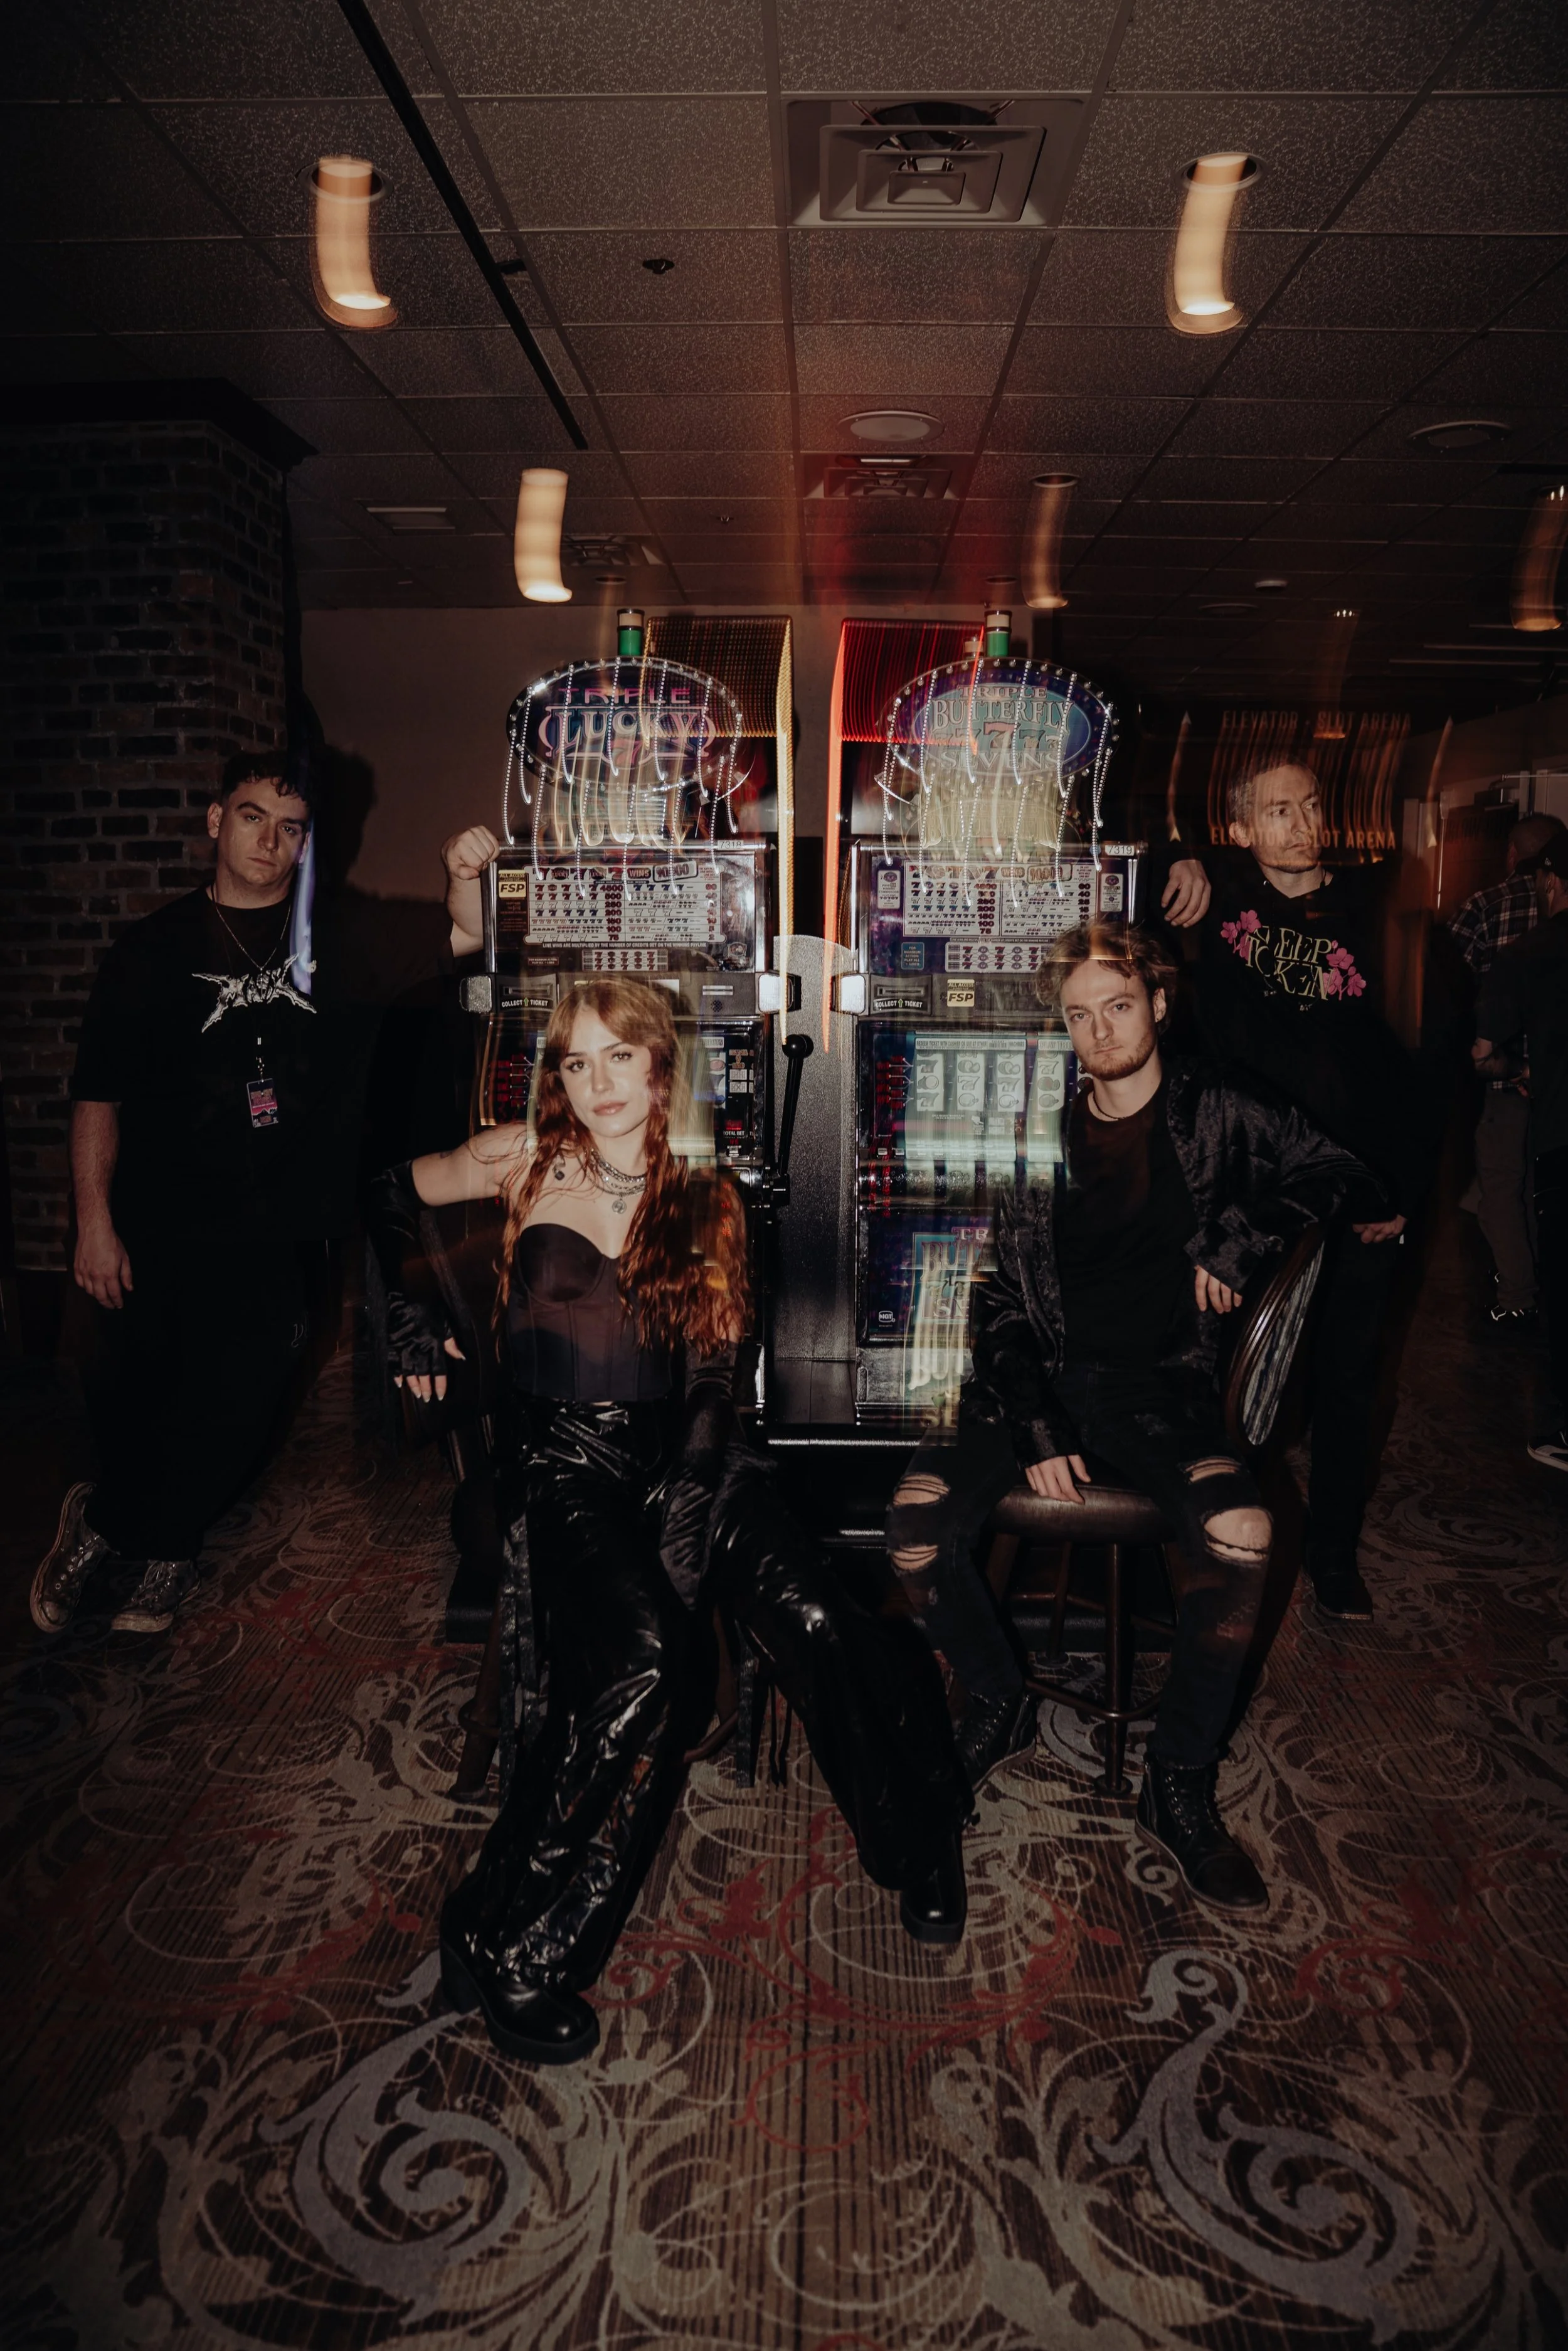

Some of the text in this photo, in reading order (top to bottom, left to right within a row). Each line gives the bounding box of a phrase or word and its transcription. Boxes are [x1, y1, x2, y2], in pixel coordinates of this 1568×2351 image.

[558, 687, 691, 704] TRIPLE
[958, 684, 1047, 699] TRIPLE
[931, 699, 1074, 734] BUTTERFLY
[1222, 710, 1411, 731] ELEVATOR SLOT ARENA
[554, 710, 698, 758] LUCKY
[940, 749, 1064, 770] SEVENS
[720, 841, 741, 849] 7318
[1345, 830, 1396, 850] ARENA
[1108, 845, 1132, 855] 7319
[629, 869, 650, 878] WINS
[501, 884, 525, 893] FSP
[502, 999, 523, 1007] COLLECT
[948, 993, 973, 1002] FSP
